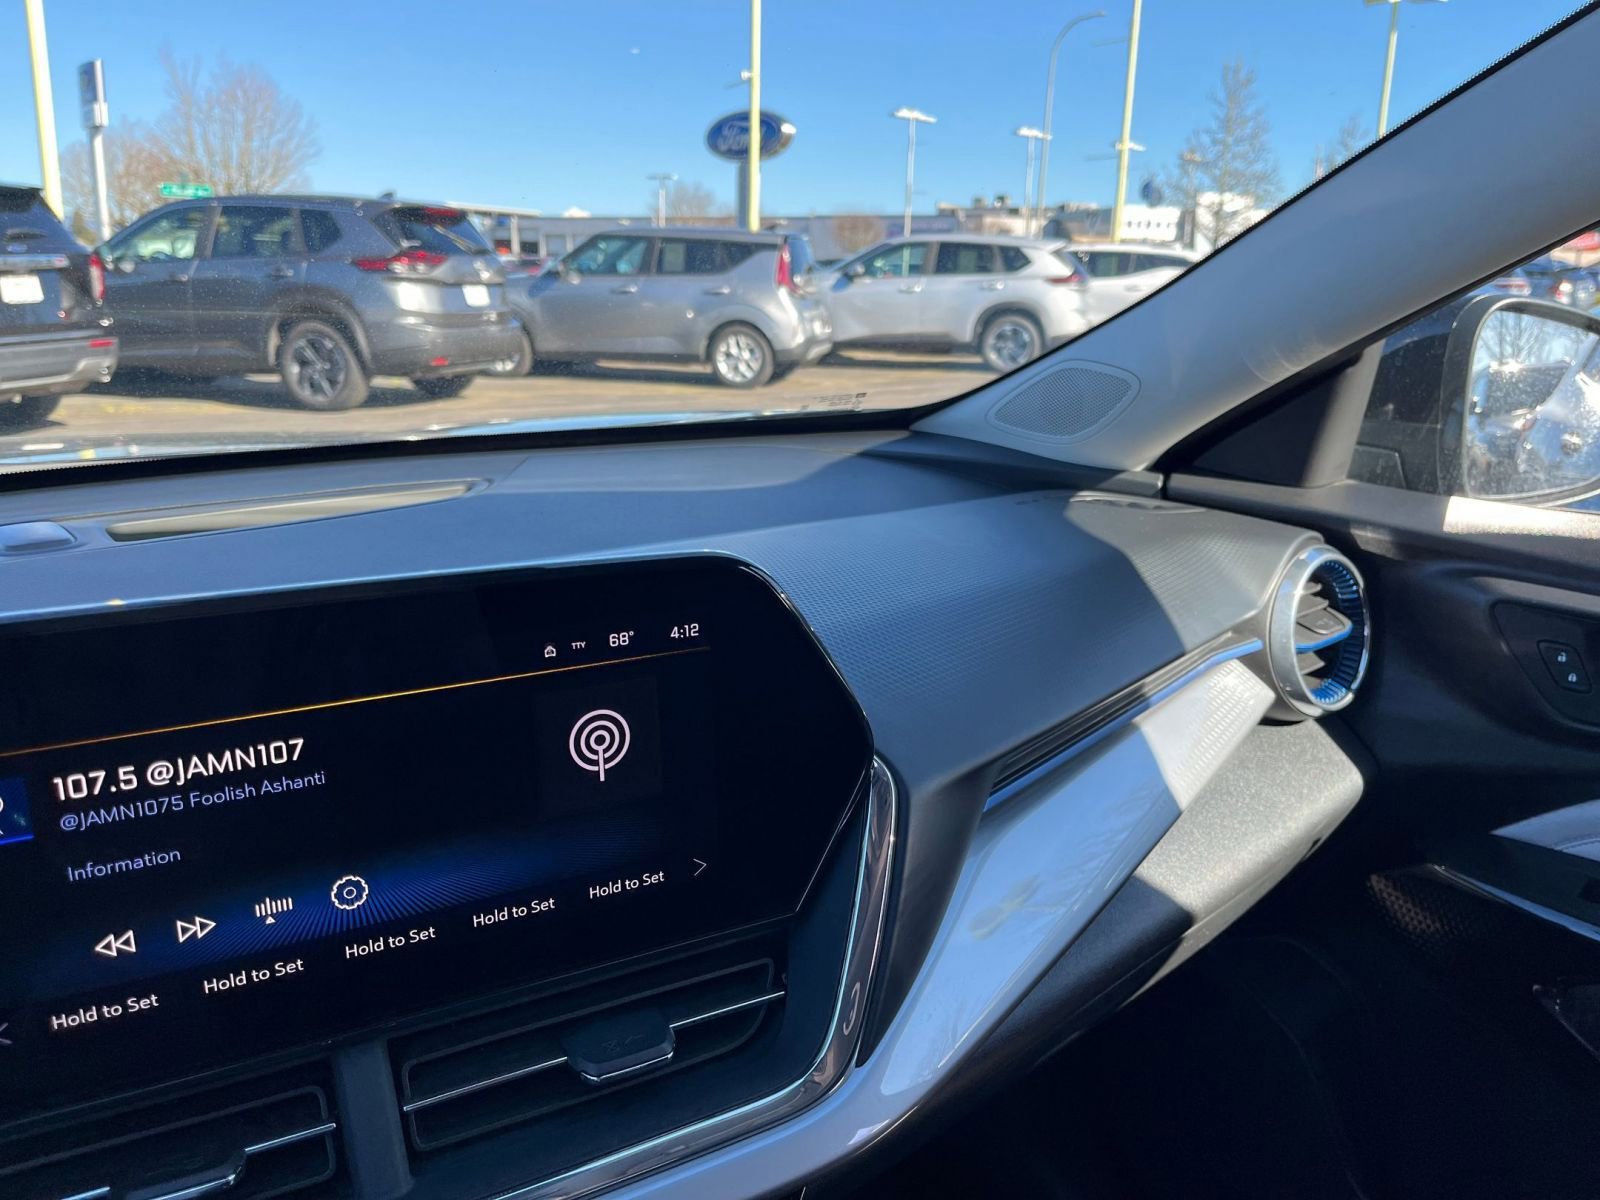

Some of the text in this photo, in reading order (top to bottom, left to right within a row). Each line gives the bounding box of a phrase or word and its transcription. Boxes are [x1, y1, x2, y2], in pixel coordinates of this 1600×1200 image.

[571, 641, 587, 650] TTY
[610, 631, 634, 647] 68°
[670, 624, 699, 638] 4:12
[53, 738, 304, 800] 107.5 @JAMN107
[60, 771, 325, 831] @JAMN1075 Foolish Ashanti
[68, 851, 180, 881] Information
[590, 871, 664, 899] Hold to Set
[473, 898, 555, 927] Hold to Set
[346, 927, 435, 958] Hold to Set
[204, 959, 304, 993] Hold to Set
[52, 994, 159, 1029] Hold to Set
